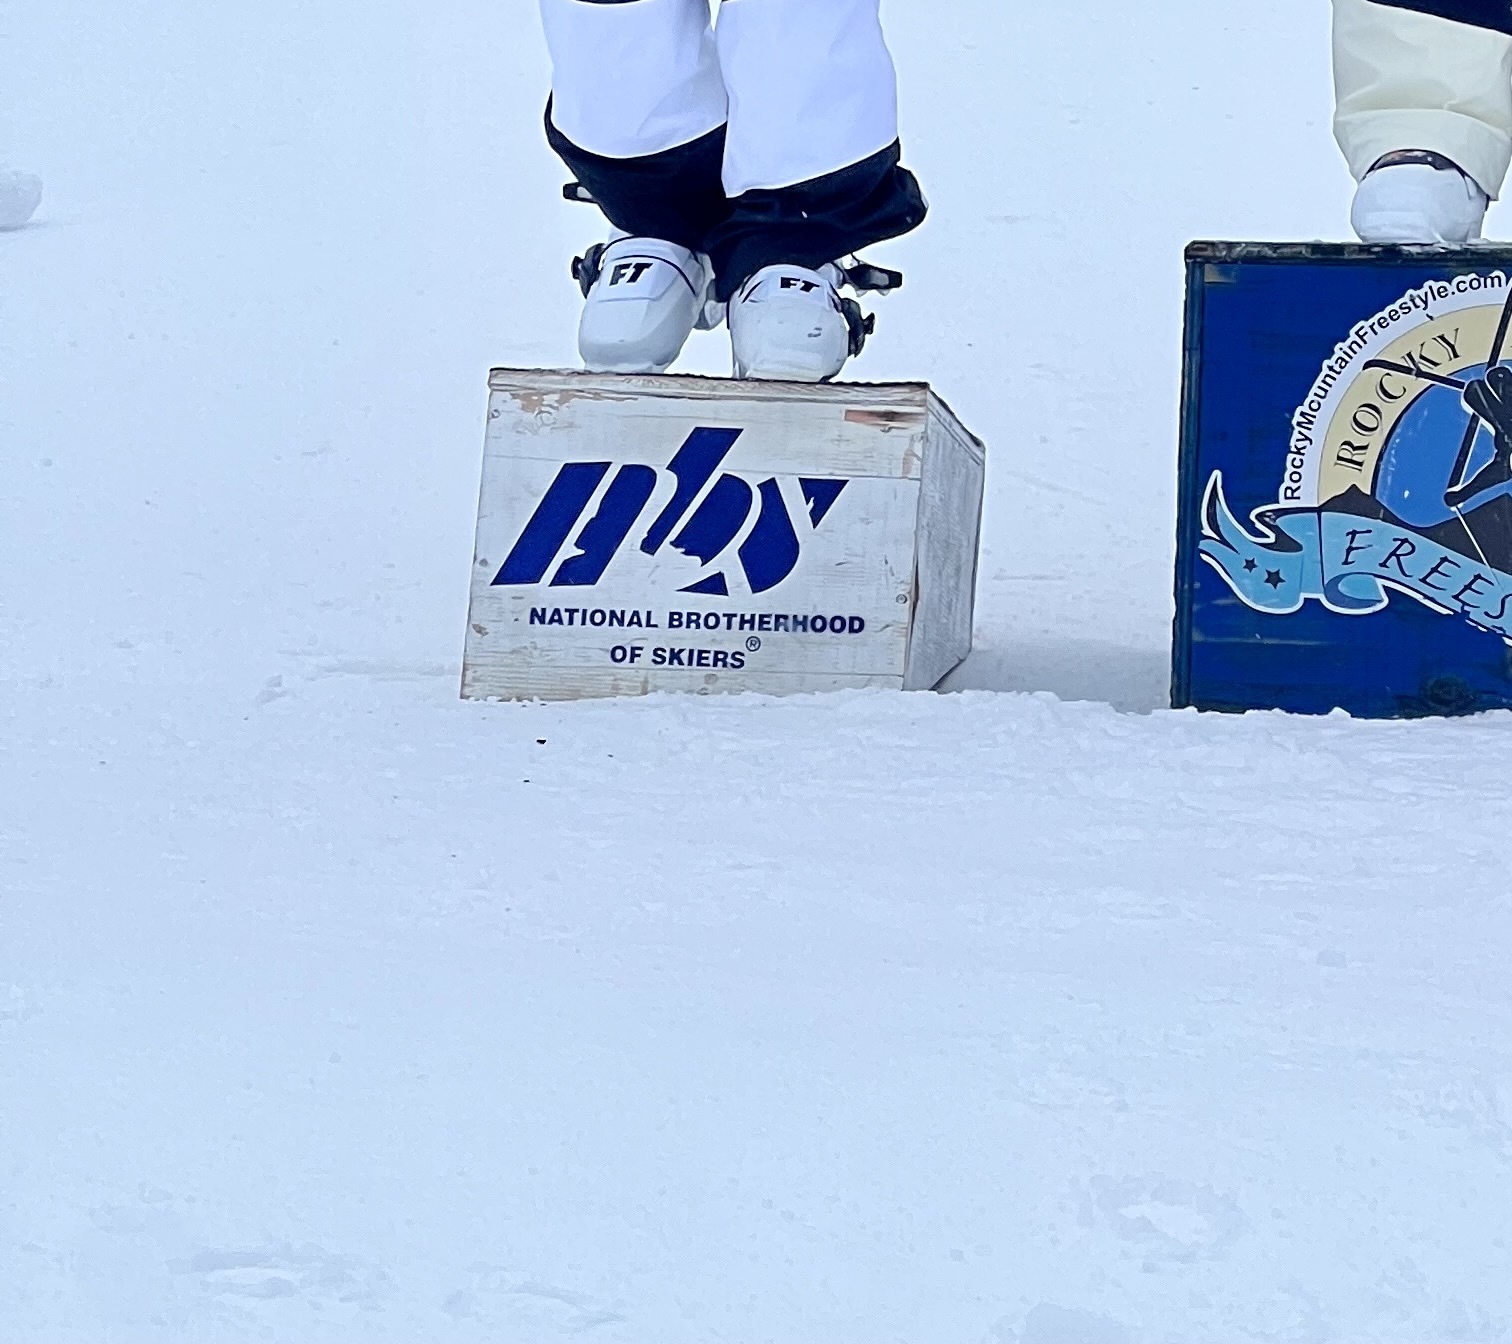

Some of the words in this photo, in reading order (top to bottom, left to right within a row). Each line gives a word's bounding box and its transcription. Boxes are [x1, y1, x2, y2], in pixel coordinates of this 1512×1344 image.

[608, 262, 653, 287] FT
[779, 276, 821, 293] FT
[1283, 274, 1504, 502] RockyMountainFreestyle.com
[1333, 328, 1464, 475] ROCKY
[529, 606, 659, 630] NATIONAL
[667, 610, 866, 635] BROTHERHOOD
[609, 644, 645, 667] OF
[651, 645, 747, 670] SKIERS
